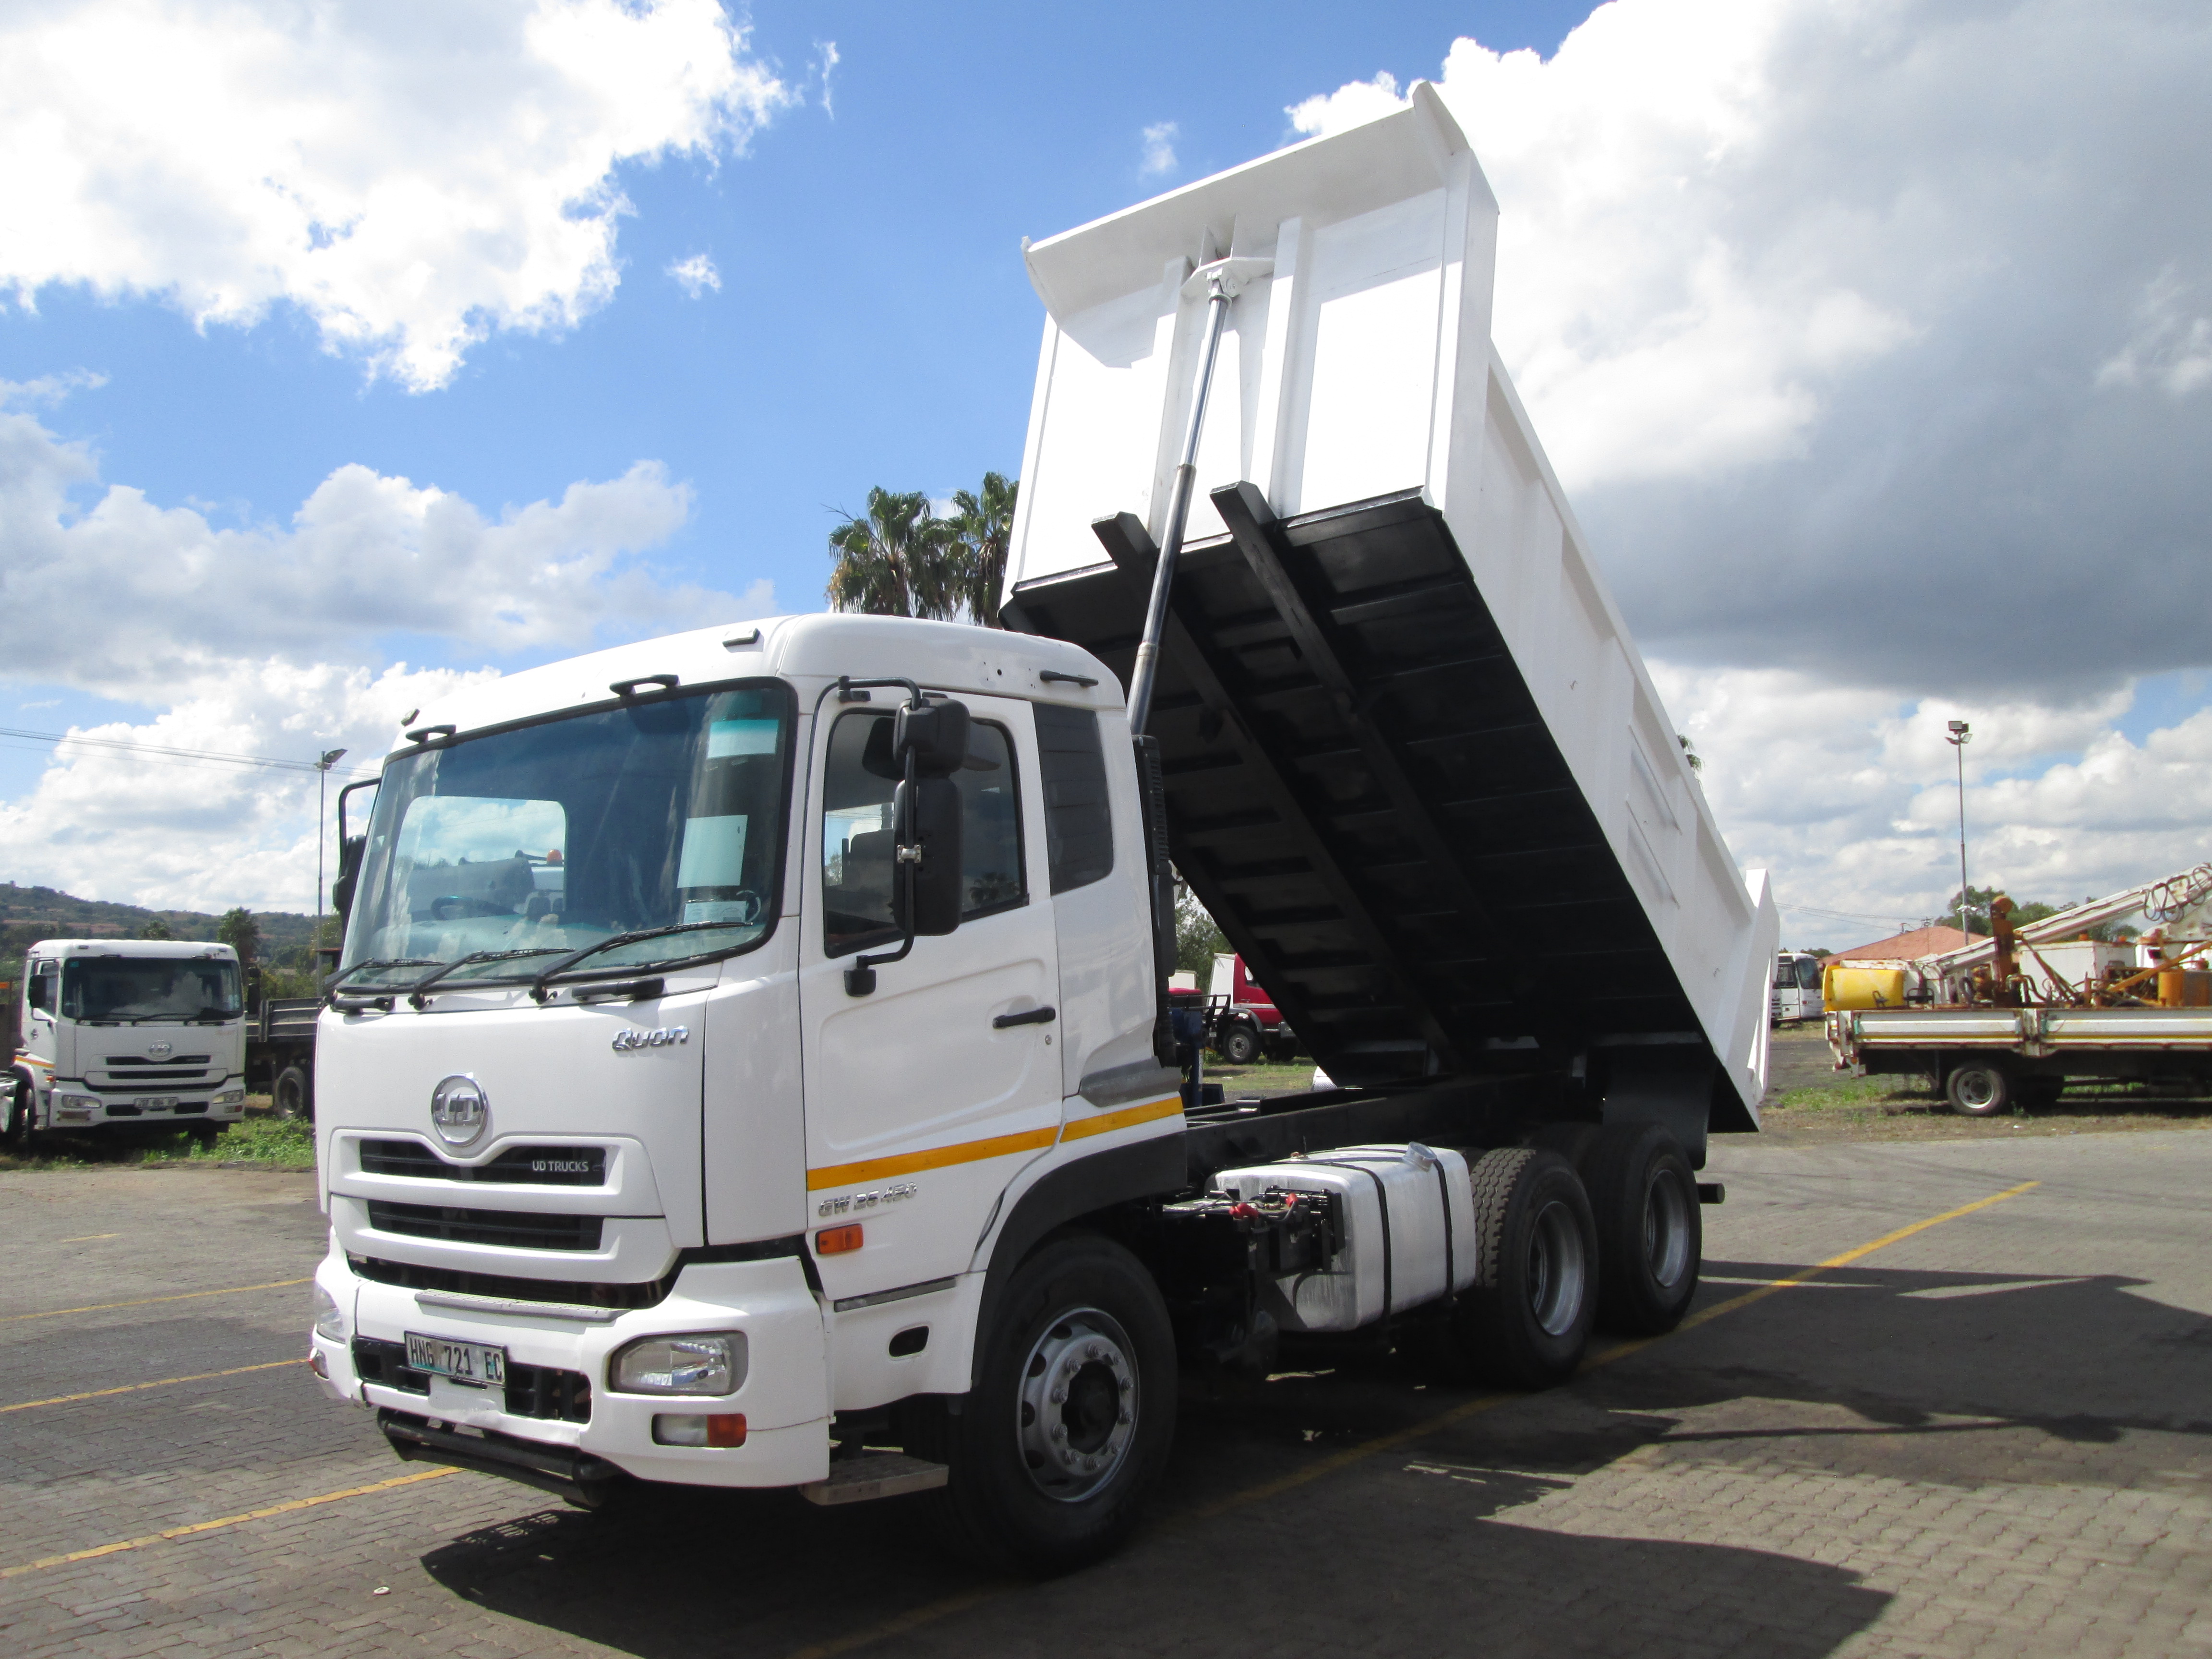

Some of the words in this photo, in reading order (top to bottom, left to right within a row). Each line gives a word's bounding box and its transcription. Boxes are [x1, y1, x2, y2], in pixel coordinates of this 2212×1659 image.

[612, 1025, 689, 1051] Quon
[433, 1093, 482, 1126] UD
[532, 1160, 546, 1171] UD
[548, 1161, 589, 1172] TRUCKS
[818, 1195, 851, 1216] GW
[410, 1337, 435, 1368] HNG
[445, 1345, 473, 1375] 721
[484, 1351, 503, 1381] EC
